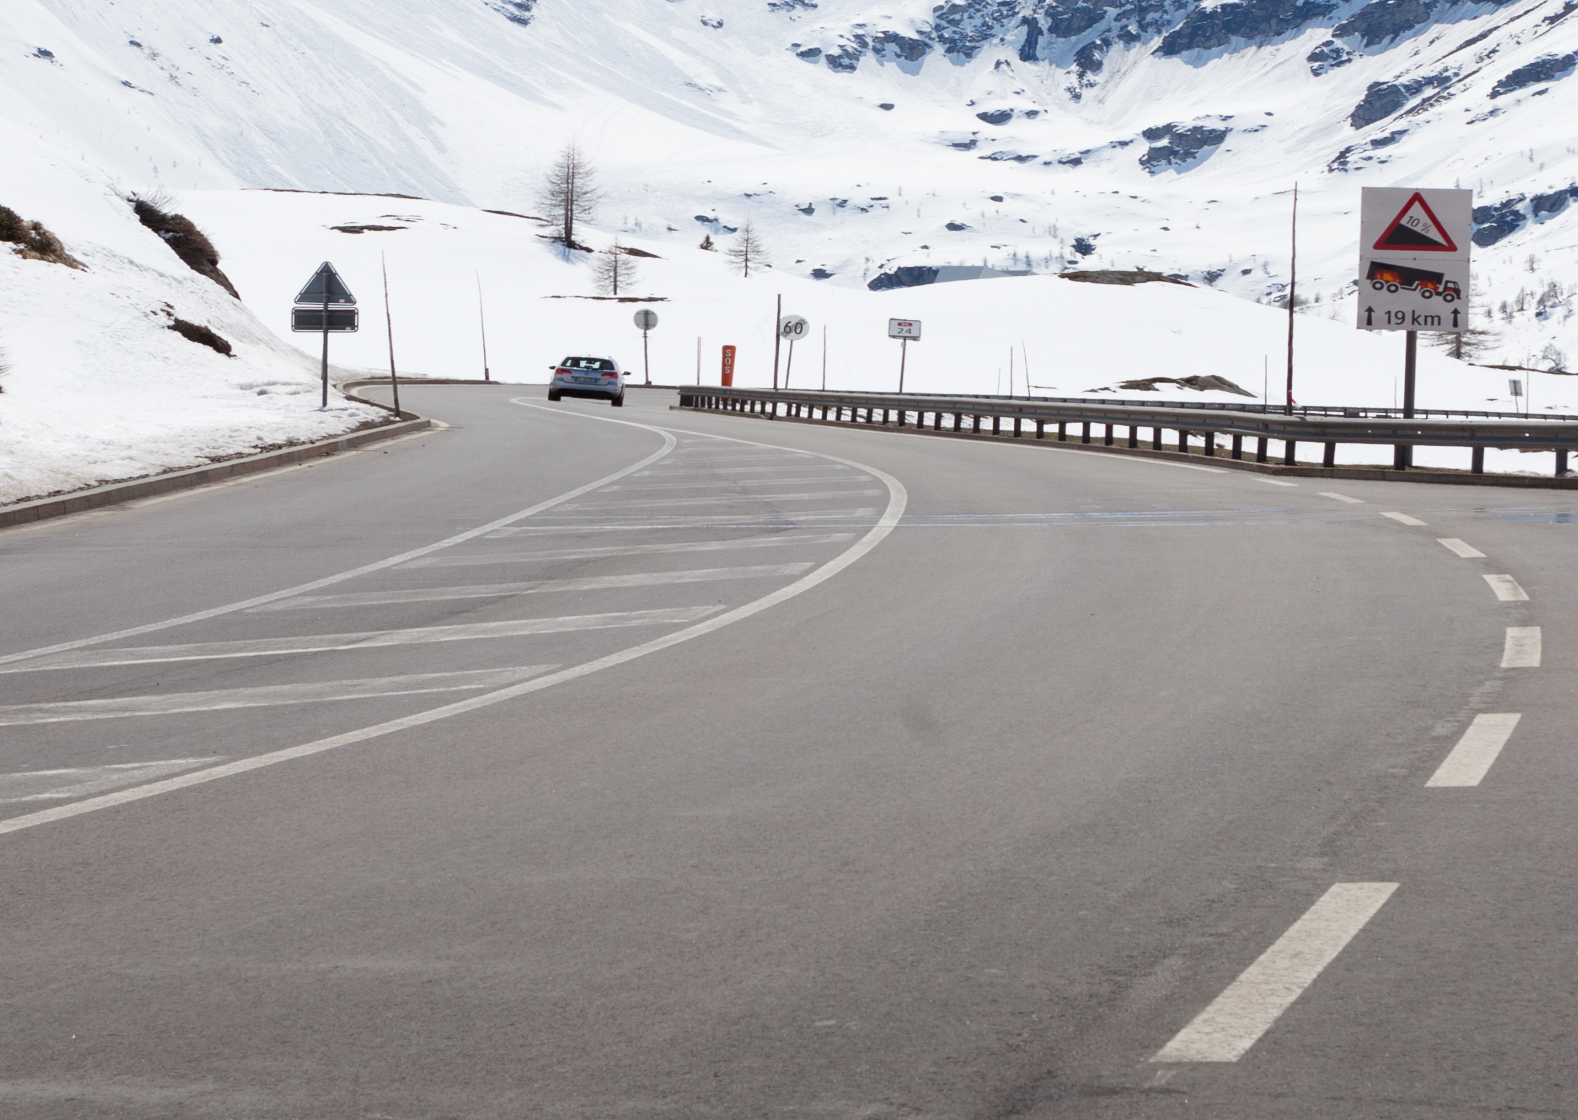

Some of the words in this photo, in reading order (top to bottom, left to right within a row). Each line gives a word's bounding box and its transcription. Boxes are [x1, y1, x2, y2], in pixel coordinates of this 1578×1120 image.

[1406, 215, 1421, 228] 10
[1421, 222, 1432, 234] %
[1384, 310, 1406, 326] 19
[1411, 309, 1442, 326] km
[783, 321, 803, 335] 60
[724, 349, 732, 374] SOS
